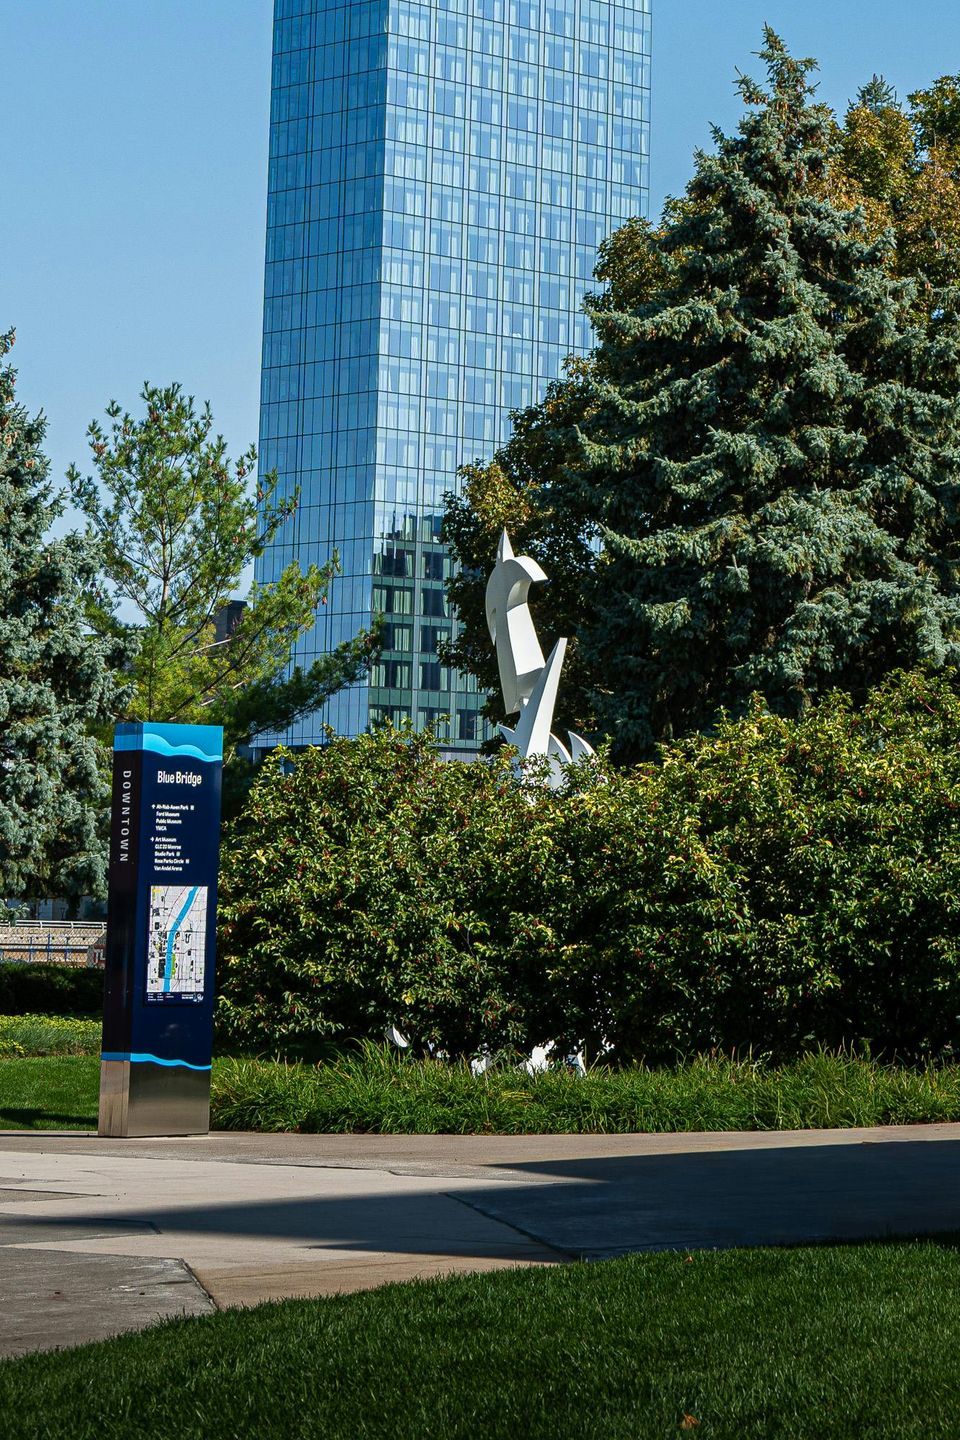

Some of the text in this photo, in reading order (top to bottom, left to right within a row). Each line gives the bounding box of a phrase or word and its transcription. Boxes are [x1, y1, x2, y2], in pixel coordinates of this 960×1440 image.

[157, 770, 202, 787] Blue Bridge
[120, 770, 132, 862] DOWNTOWN
